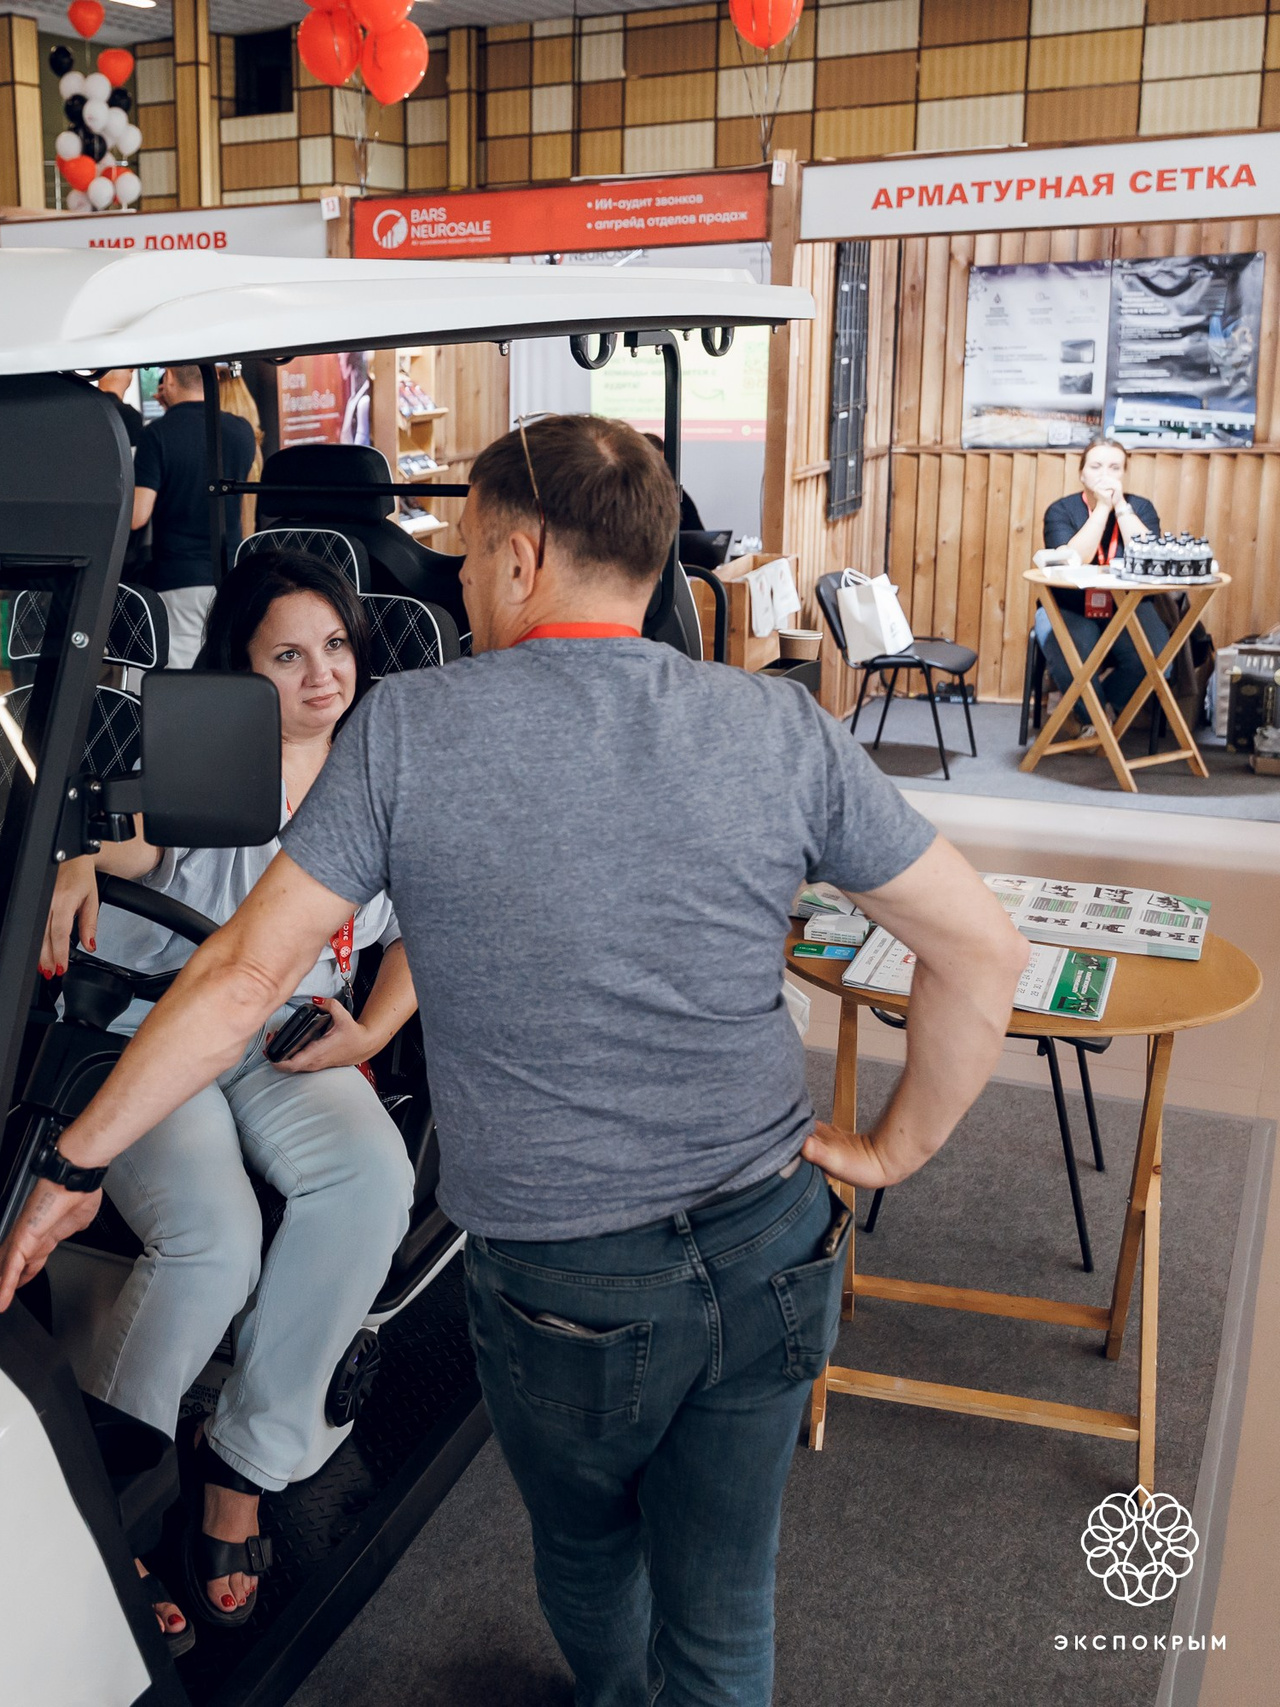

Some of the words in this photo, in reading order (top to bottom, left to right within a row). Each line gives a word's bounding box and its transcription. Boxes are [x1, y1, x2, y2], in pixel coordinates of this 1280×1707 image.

[871, 172, 1115, 210] АРМАТУРНАЯ
[1128, 163, 1257, 194] СЕТКА
[655, 194, 704, 207] звонков
[410, 207, 447, 223] BARS
[594, 216, 646, 231] апгрейд
[646, 214, 696, 227] отделов
[699, 211, 748, 225] продаж
[410, 220, 492, 239] NEUROSALE
[144, 230, 228, 250] ДОМОВ
